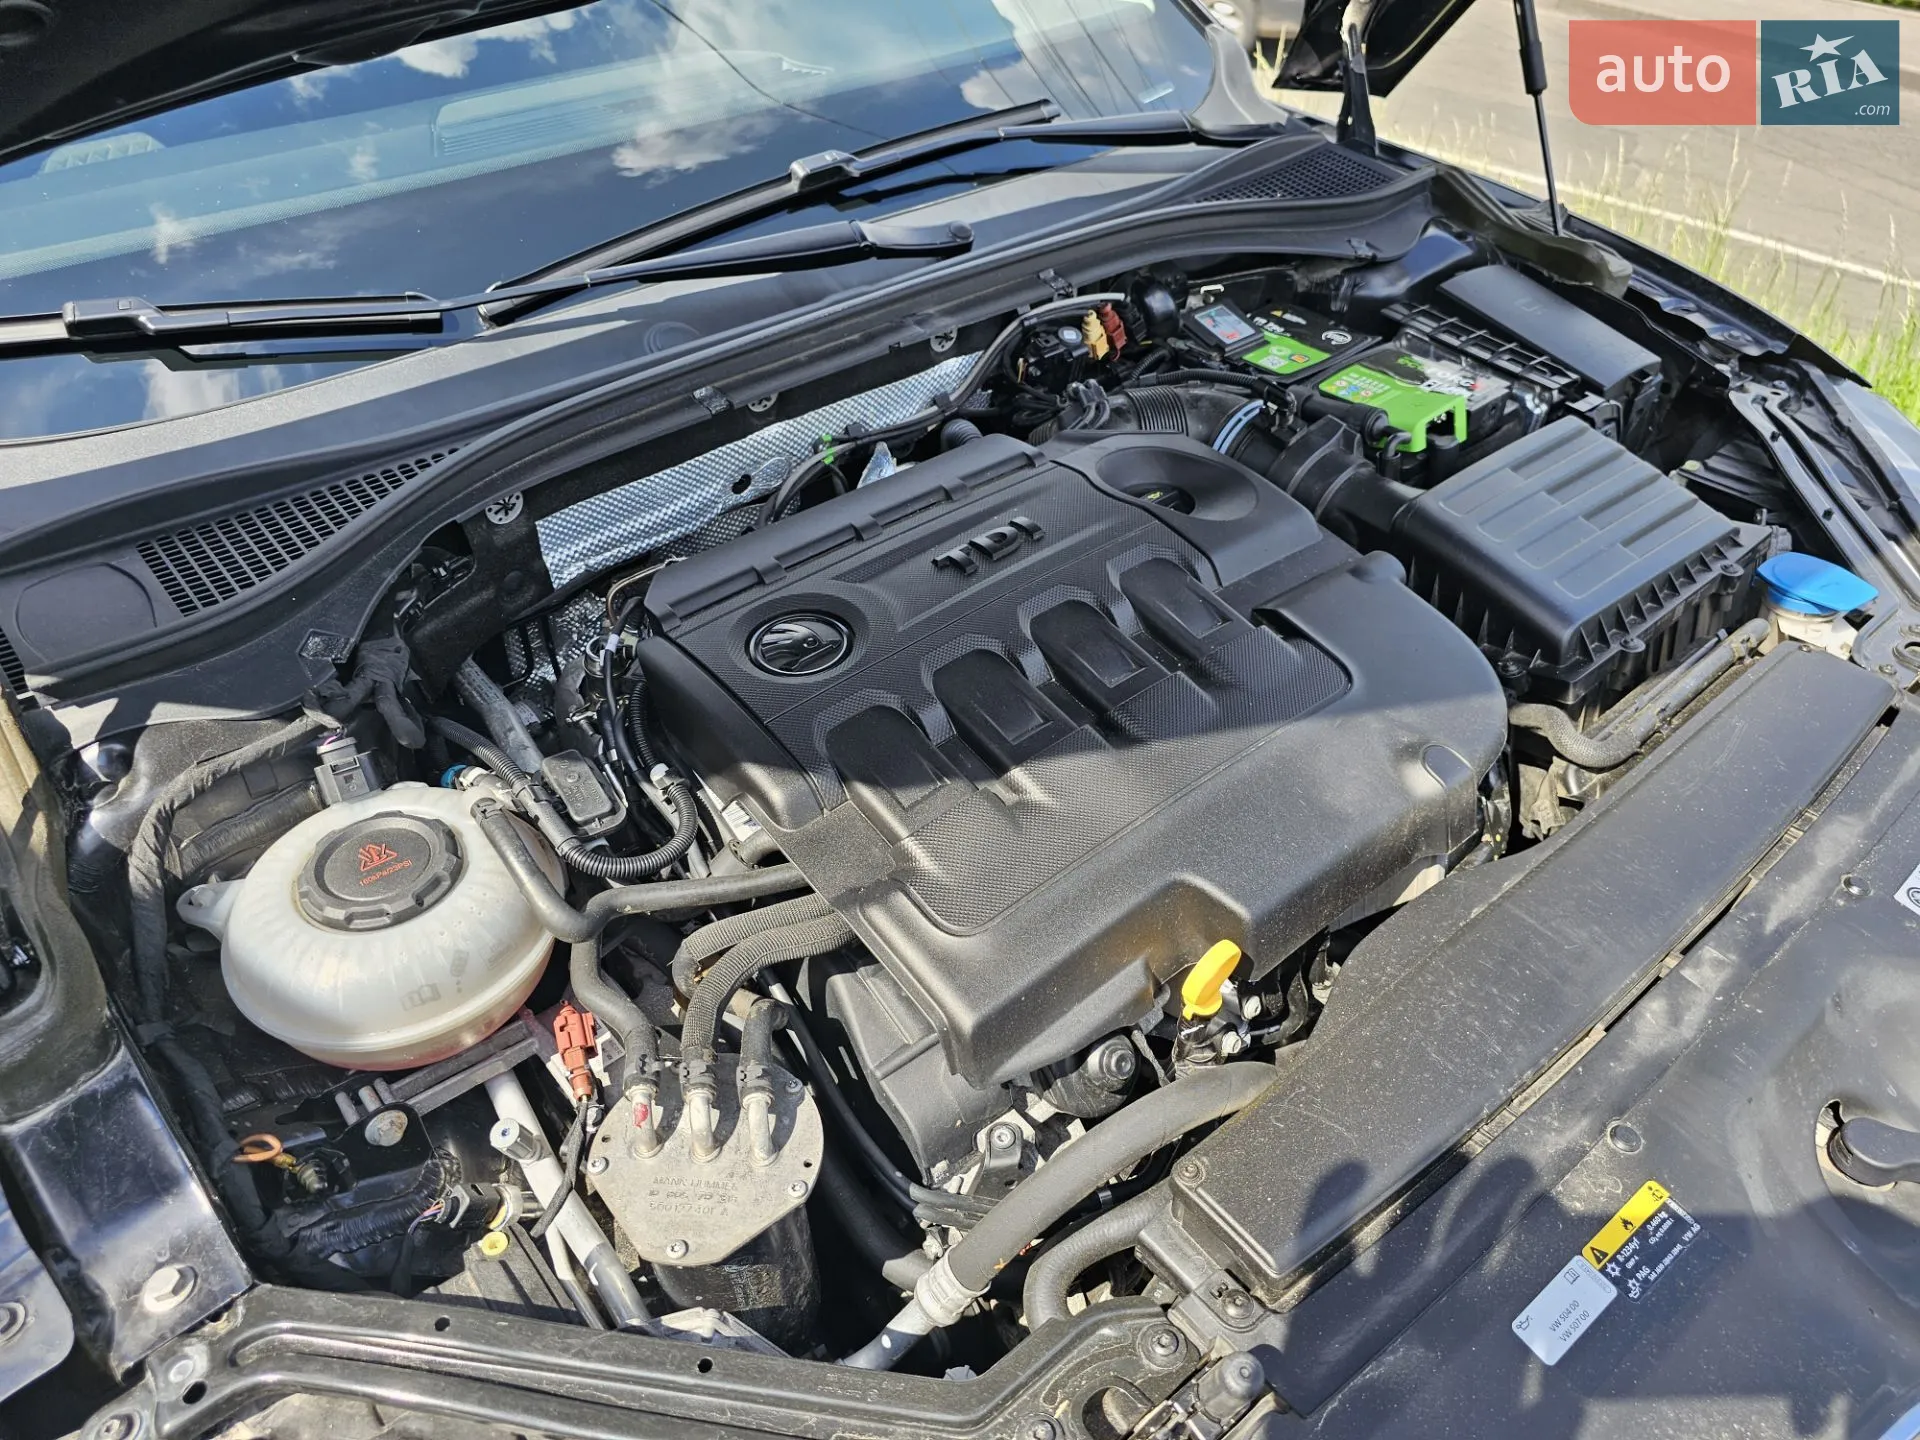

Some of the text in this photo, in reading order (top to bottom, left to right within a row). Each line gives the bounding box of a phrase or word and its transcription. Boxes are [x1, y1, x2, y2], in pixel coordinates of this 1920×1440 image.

[931, 516, 1046, 576] TDI
[1681, 1229, 1694, 1242] VW
[1690, 1222, 1701, 1234] AG
[1616, 1236, 1640, 1263] R-1234yf
[1636, 1265, 1651, 1281] PAG
[1549, 1300, 1580, 1332] VW 504 00
[1559, 1310, 1590, 1342] VW 507 00
